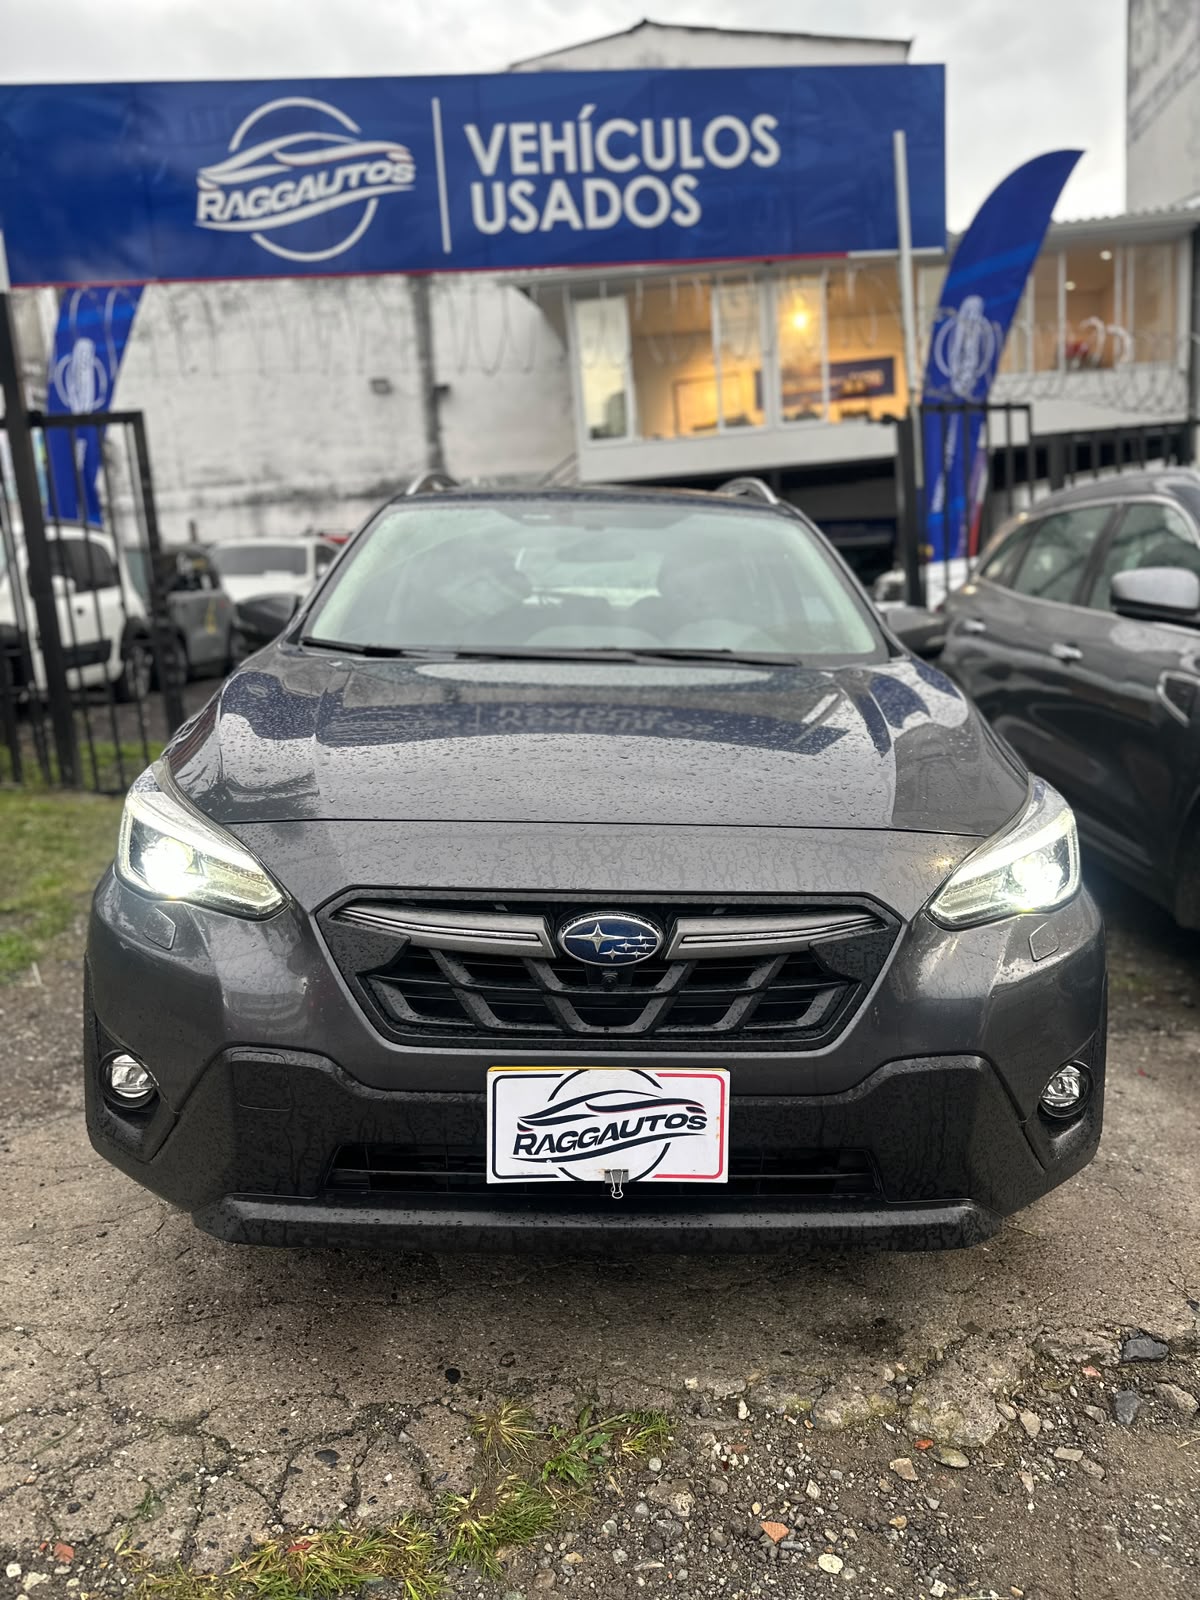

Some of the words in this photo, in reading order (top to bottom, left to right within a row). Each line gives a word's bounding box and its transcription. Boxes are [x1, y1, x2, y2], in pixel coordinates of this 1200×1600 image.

[463, 104, 780, 176] VEHÍCULOS
[196, 161, 416, 221] RAGGAUTOS
[471, 173, 701, 234] USADOS
[513, 1113, 708, 1156] RAGGAUTOS
